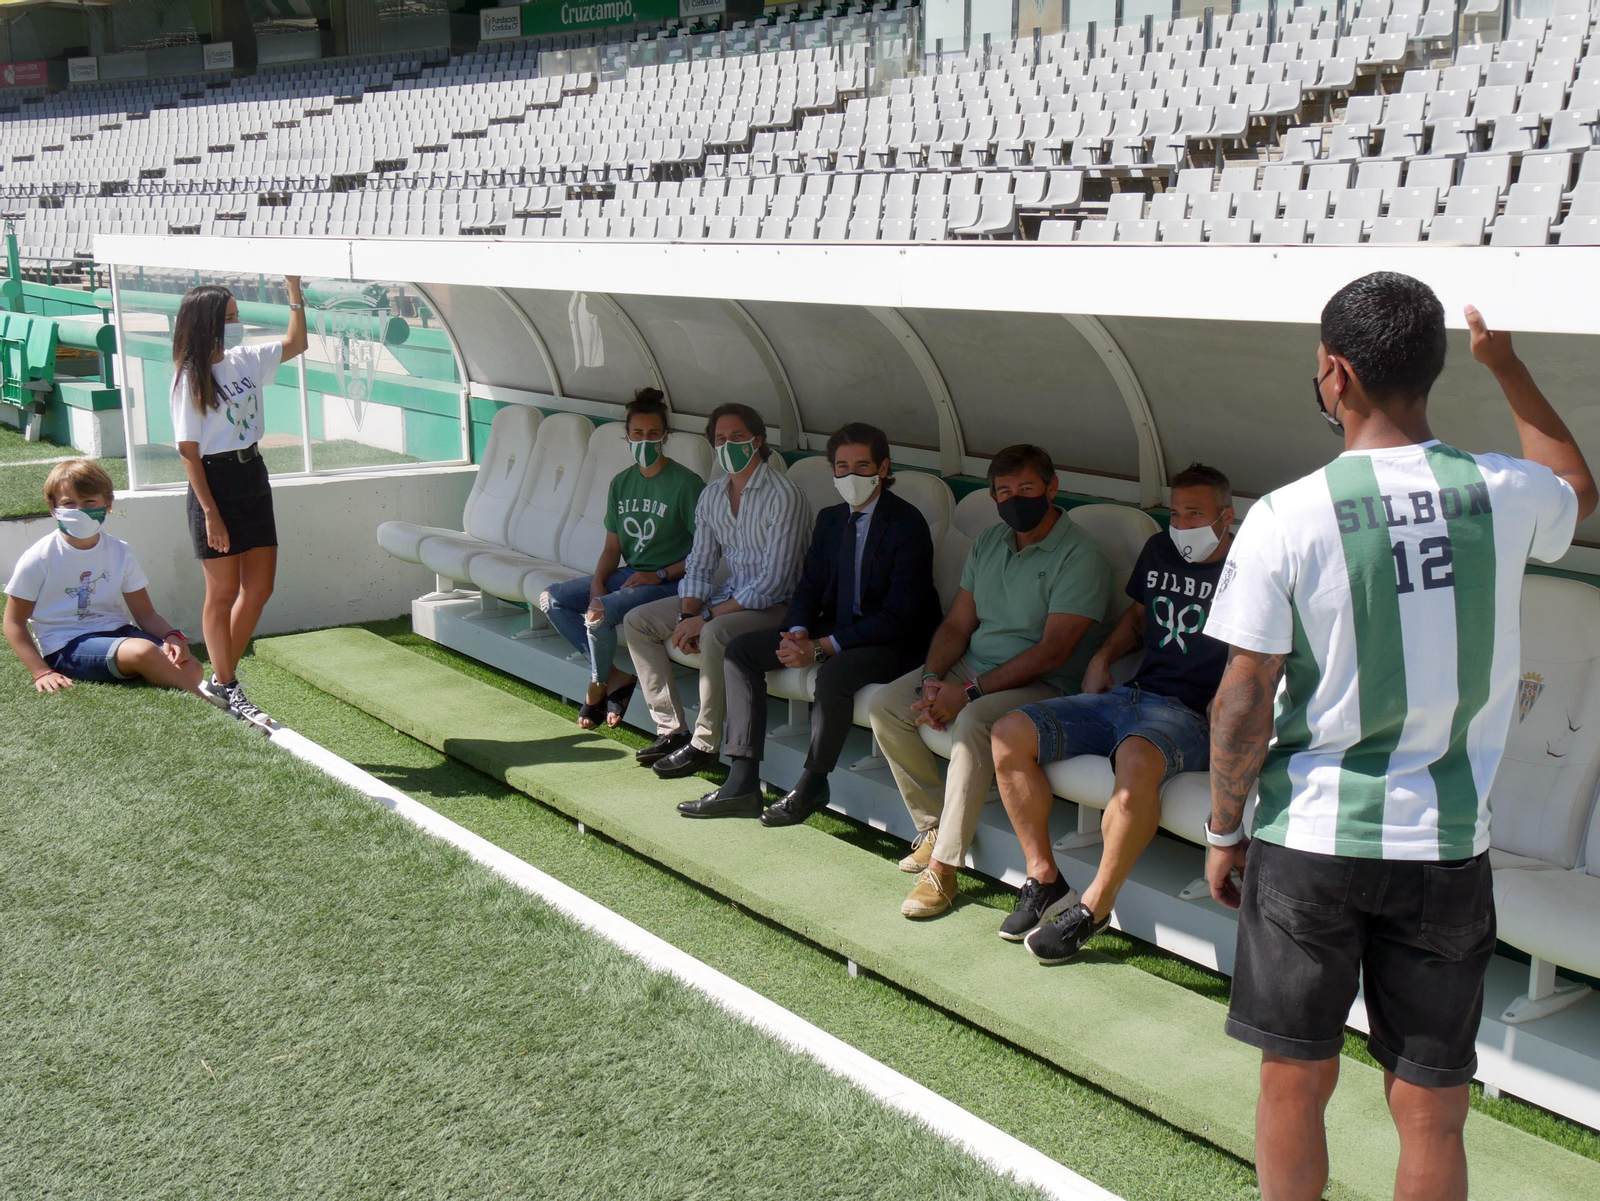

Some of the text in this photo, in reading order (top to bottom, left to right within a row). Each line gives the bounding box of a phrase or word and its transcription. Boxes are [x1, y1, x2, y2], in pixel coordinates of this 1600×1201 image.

[491, 15, 518, 25] Fundación
[561, 0, 632, 24] Cruzcampo
[618, 498, 668, 518] SILBON
[1333, 481, 1492, 534] SILBON
[1391, 536, 1456, 594] 12
[1147, 570, 1213, 602] SILBO
